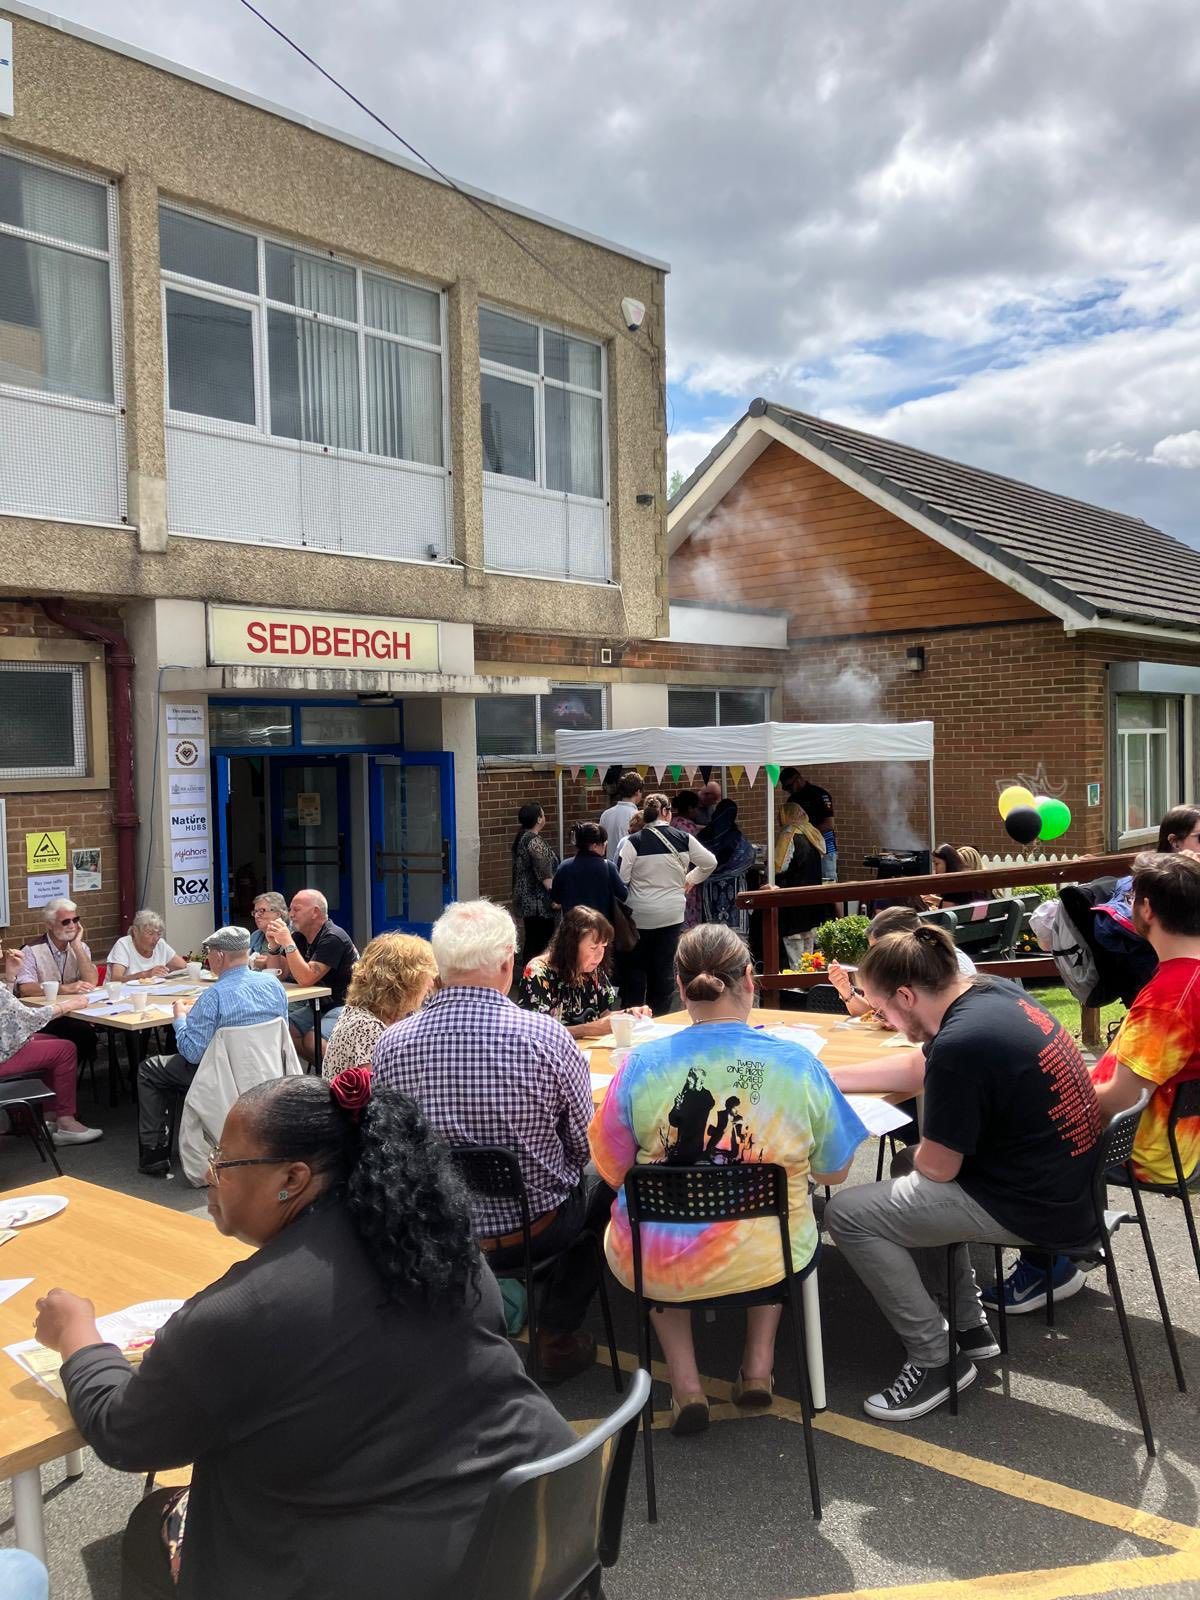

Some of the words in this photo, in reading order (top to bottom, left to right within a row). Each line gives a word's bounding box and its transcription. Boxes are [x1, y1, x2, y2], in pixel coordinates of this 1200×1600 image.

[246, 621, 411, 660] SEDBERGH
[185, 823, 207, 832] HUBS
[173, 877, 209, 896] Rex
[174, 893, 209, 904] LONDON
[738, 1059, 766, 1068] TWENTY
[733, 1081, 749, 1089] AND
